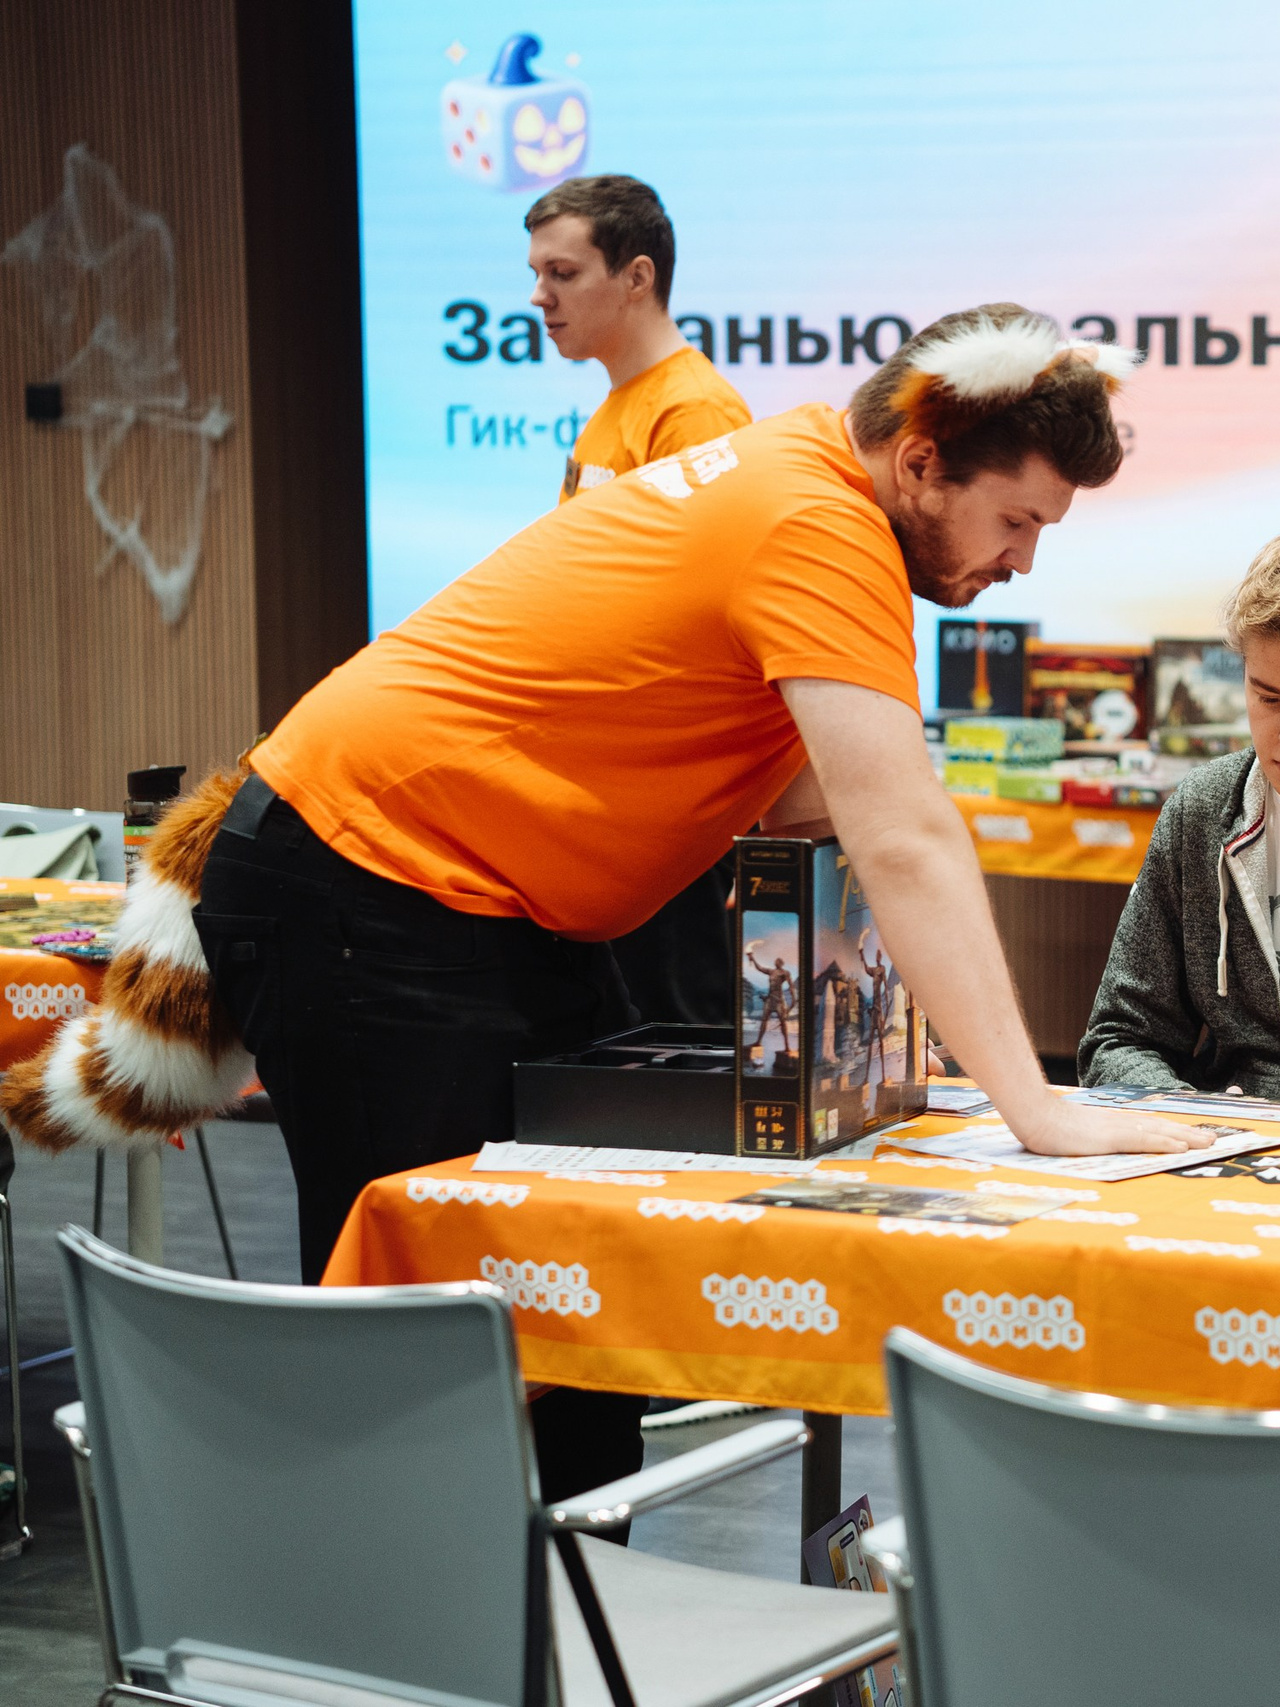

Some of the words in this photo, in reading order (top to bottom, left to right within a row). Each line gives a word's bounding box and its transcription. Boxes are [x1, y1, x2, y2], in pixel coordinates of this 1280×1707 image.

[444, 301, 542, 363] За
[572, 314, 913, 365] анью
[447, 405, 588, 448] Гик-ф
[8, 986, 81, 1000] HOBBY
[483, 1260, 585, 1287] HOBBY
[503, 1285, 594, 1311] AMES
[707, 1279, 820, 1303] HOBBY
[721, 1303, 832, 1328] GAMES
[949, 1295, 1068, 1320] HOBBY
[961, 1319, 1081, 1345] GAMES
